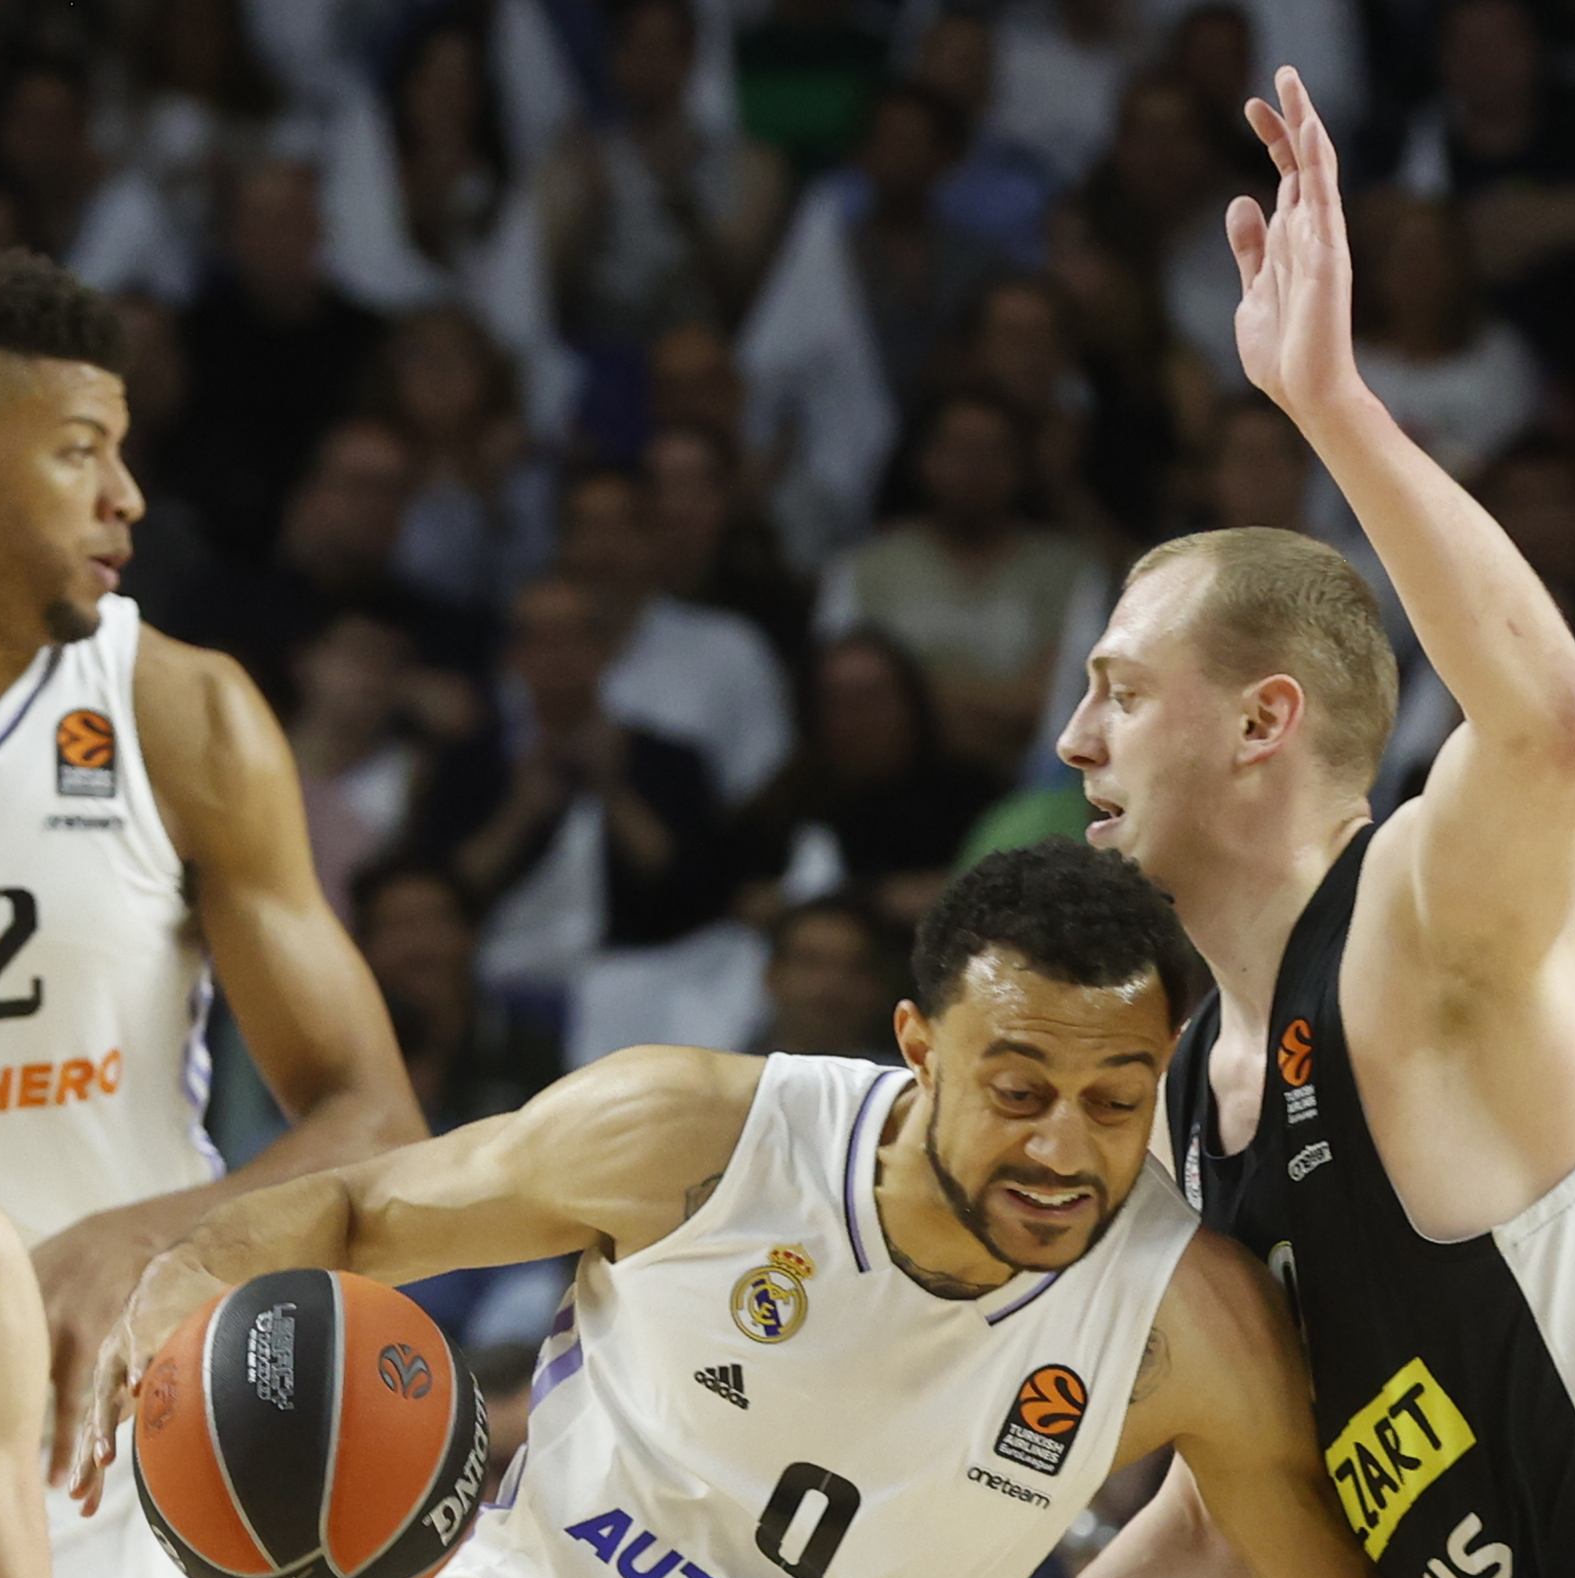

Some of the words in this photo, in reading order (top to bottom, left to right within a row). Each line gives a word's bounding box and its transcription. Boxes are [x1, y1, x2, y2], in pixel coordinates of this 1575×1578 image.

[426, 1372, 489, 1547] LDING
[966, 1466, 1052, 1510] oneteam
[1335, 1382, 1441, 1541] ZART
